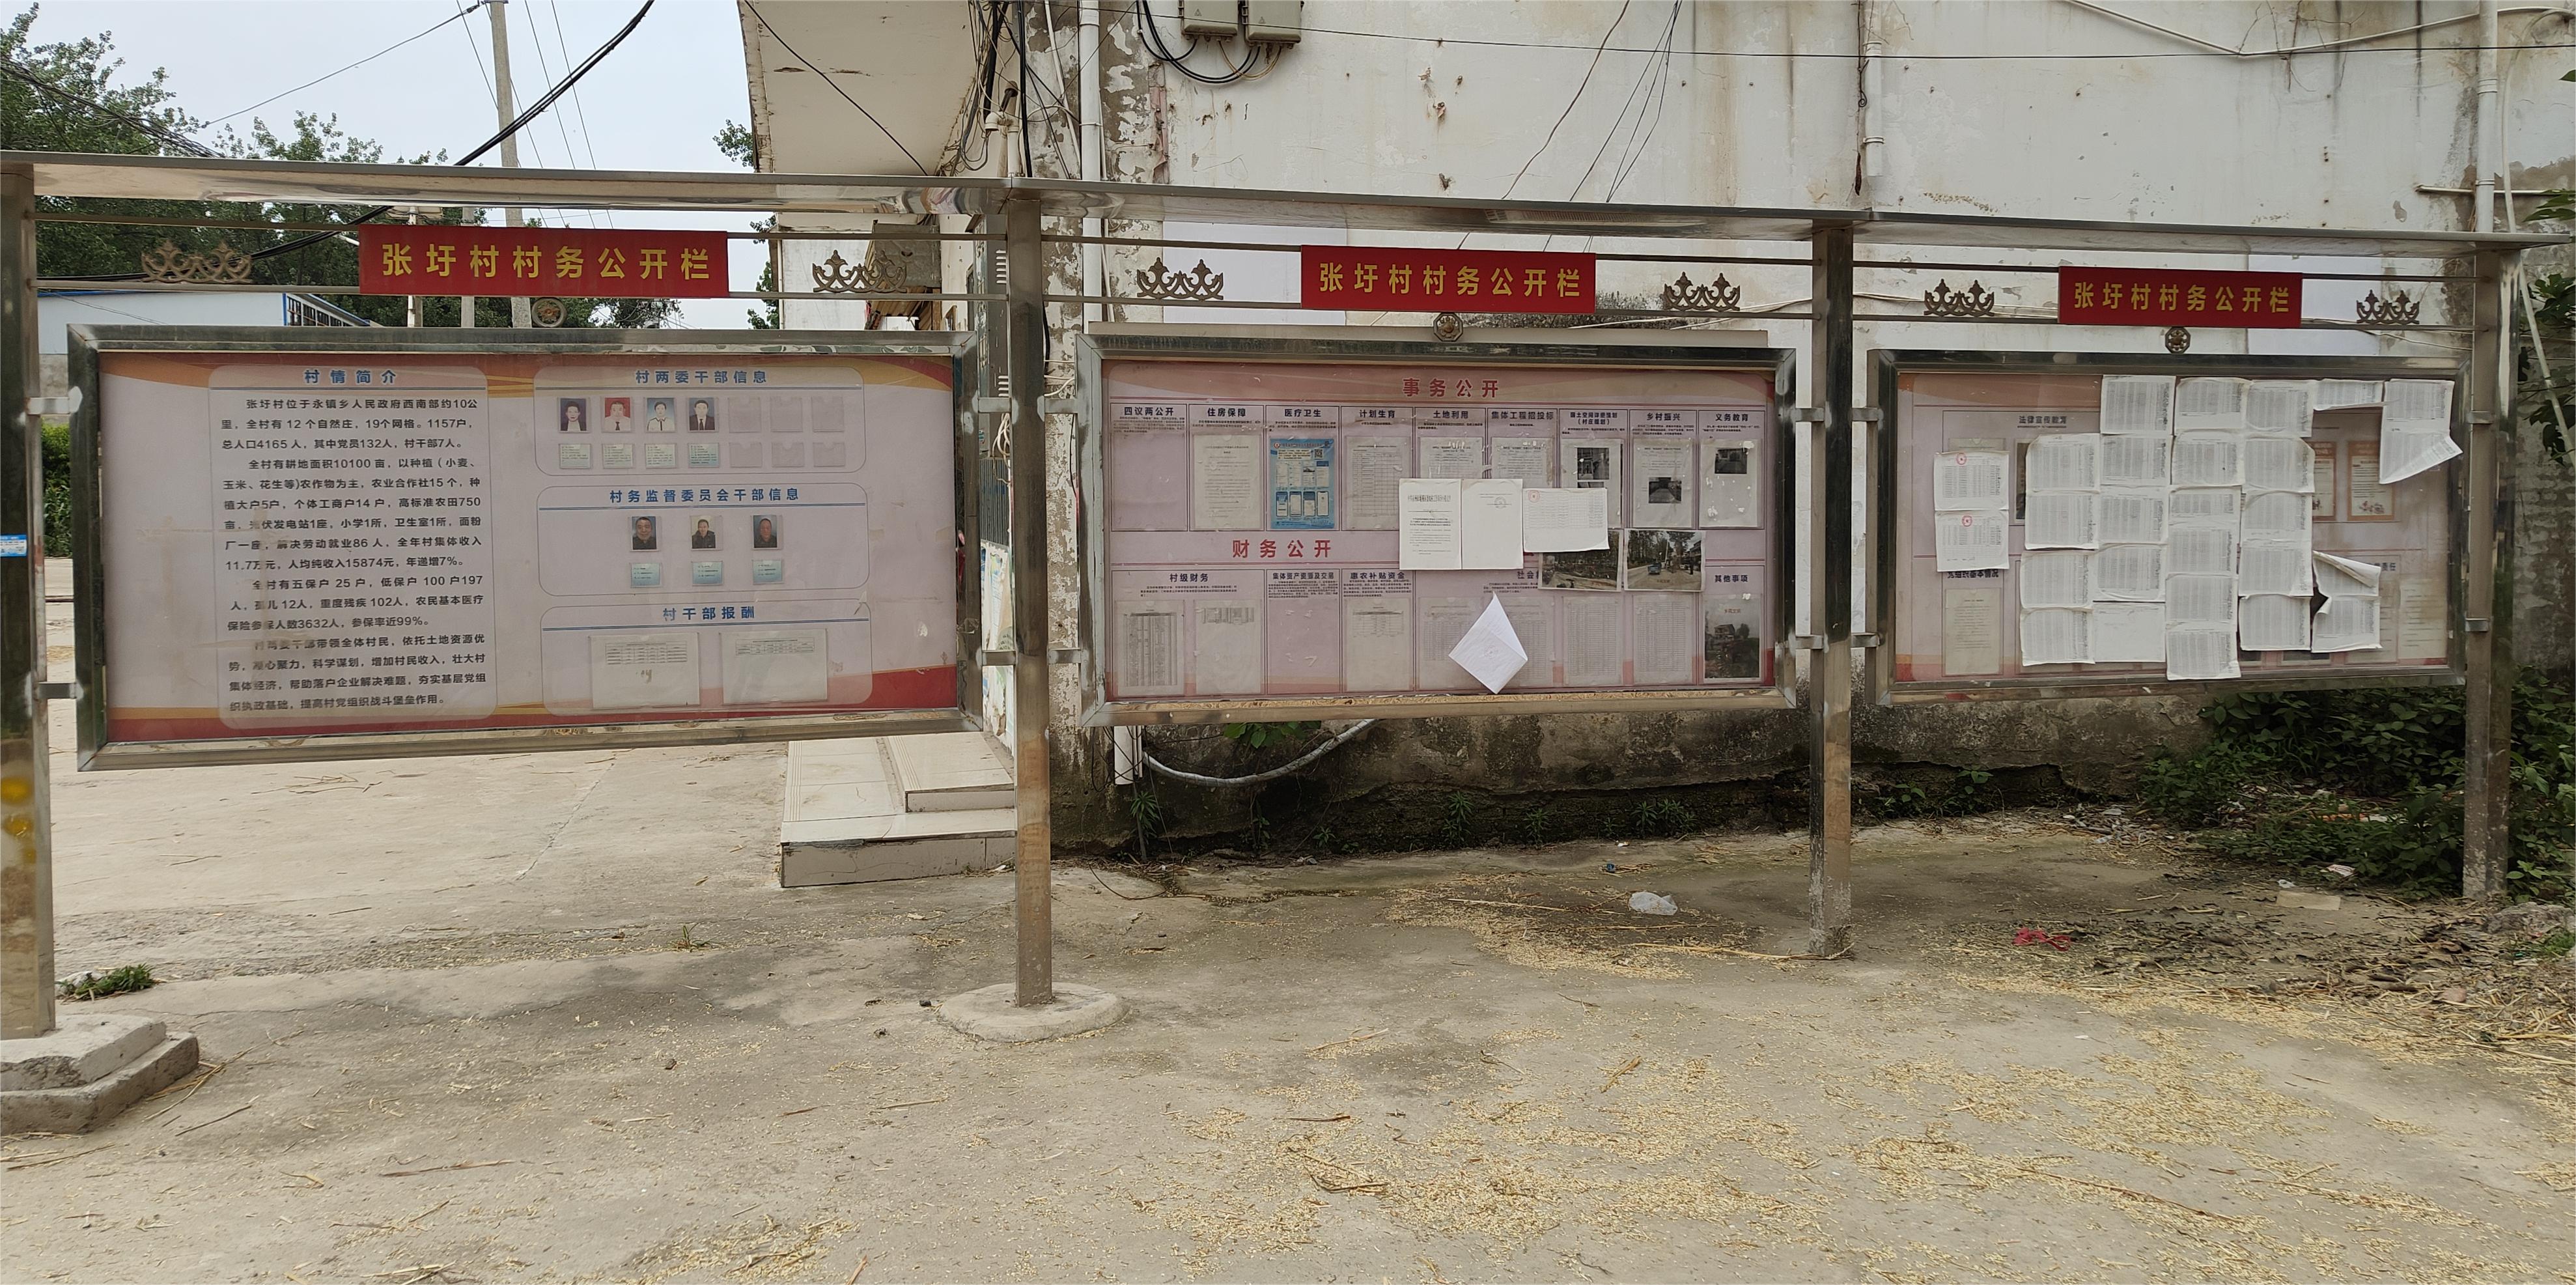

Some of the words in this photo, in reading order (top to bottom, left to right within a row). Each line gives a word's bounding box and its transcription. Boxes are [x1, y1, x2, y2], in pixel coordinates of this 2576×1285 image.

[382, 243, 710, 280] 张圩村村务公开栏
[1319, 262, 1580, 297] 张圩村村务公开栏
[2074, 282, 2289, 313] 张圩村村务公开栏
[304, 370, 397, 384] 村情简介
[636, 370, 767, 384] 村两委干部信息
[1403, 378, 1499, 397] 事务公开
[246, 399, 478, 409] 张圩村位于永镇乡人民政府西南部约10公
[1124, 406, 1175, 417] 四议两公开
[1207, 408, 1246, 417] 住房保障
[1284, 408, 1322, 417] 医疗卫生
[1359, 409, 1396, 419] 计划生育
[1433, 410, 1469, 419] 土地利用
[1491, 411, 1554, 420] 集体工程招投标
[1646, 412, 1681, 421] 乡村振兴
[1715, 413, 1749, 422] 义务教育
[2019, 416, 2067, 424] 法律宣传教育
[609, 488, 800, 503] 村务监督委员会干部信息
[1232, 539, 1332, 559] 财务公开
[1169, 572, 1209, 582] 村级财务
[1517, 571, 1539, 579] 社会
[1715, 574, 1748, 583] 其他事项
[663, 606, 755, 621] 村干部报酬
